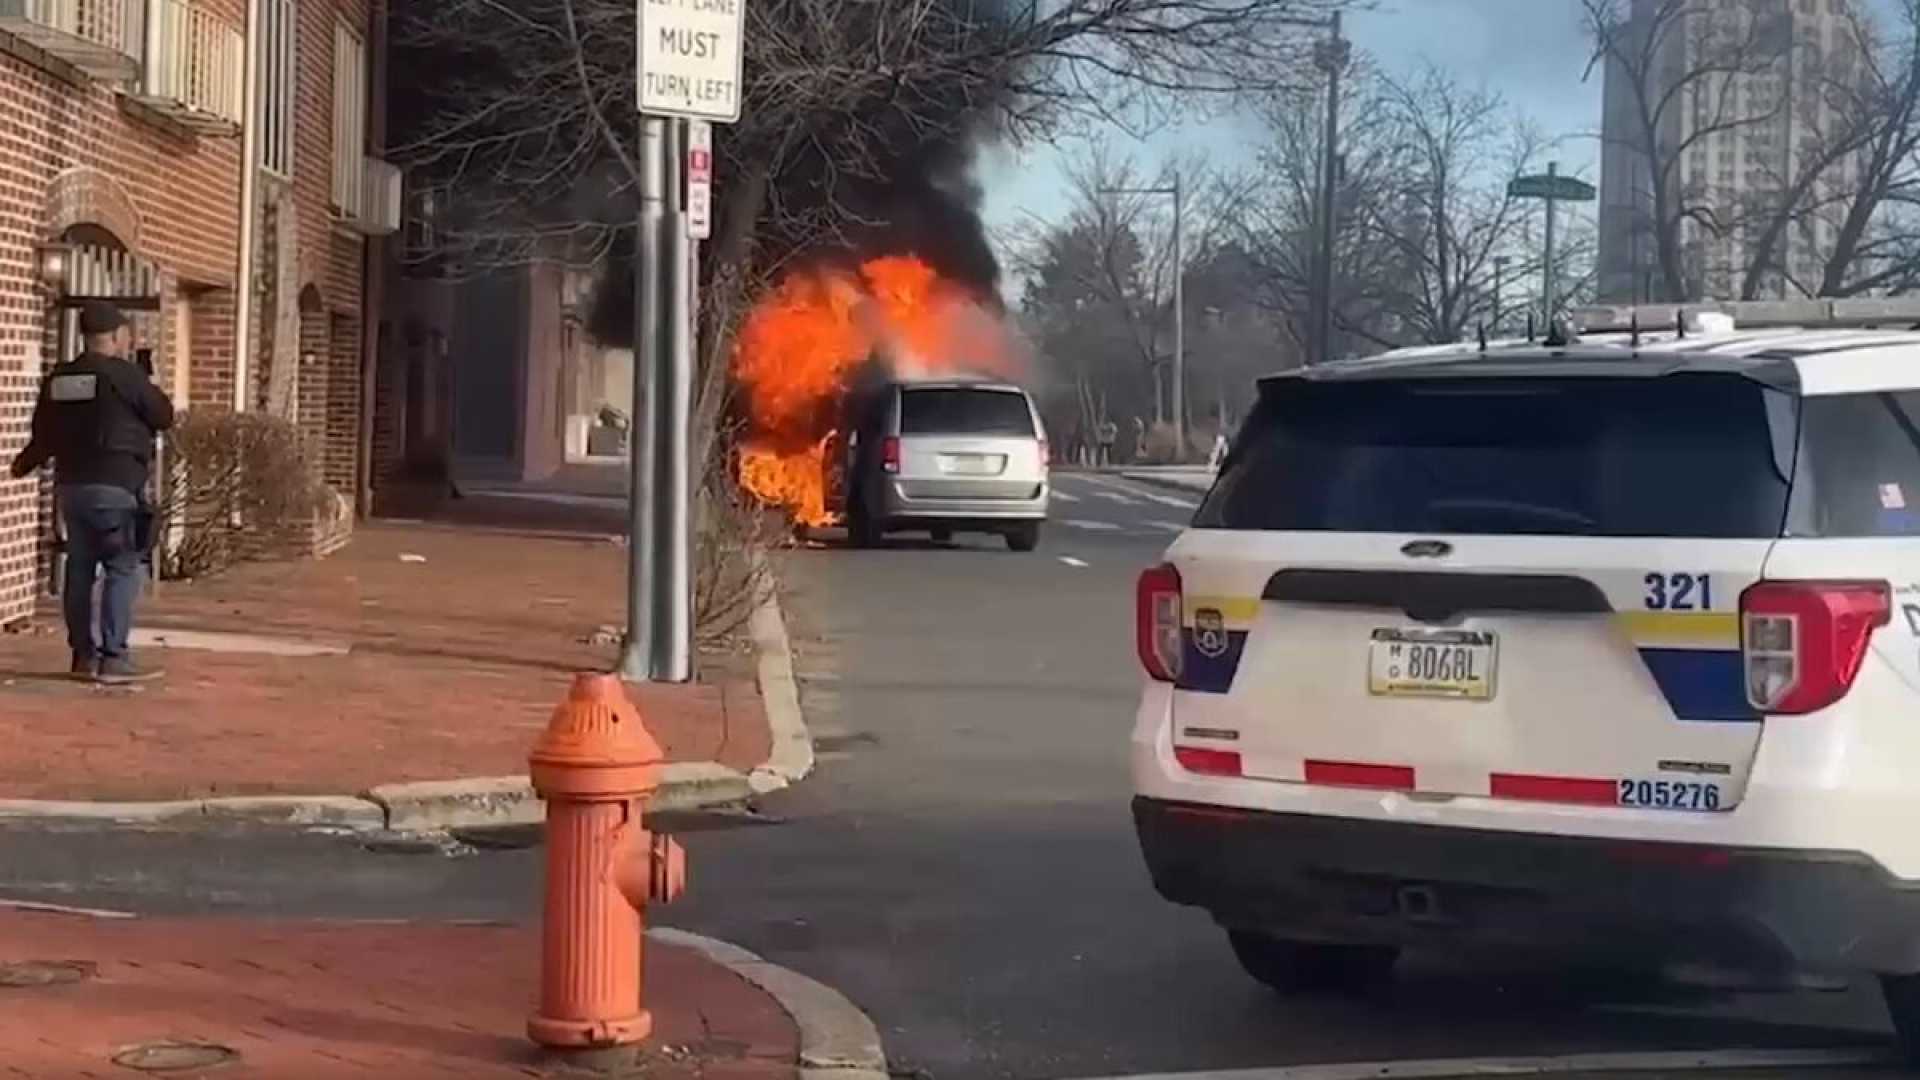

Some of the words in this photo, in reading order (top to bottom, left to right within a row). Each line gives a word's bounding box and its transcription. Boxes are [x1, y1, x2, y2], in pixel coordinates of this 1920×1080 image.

[660, 27, 720, 59] MUST
[646, 72, 690, 97] TURN
[696, 78, 733, 104] LEFT
[1644, 572, 1710, 610] 321
[1408, 645, 1480, 681] 8068L
[1620, 779, 1719, 810] 205276
